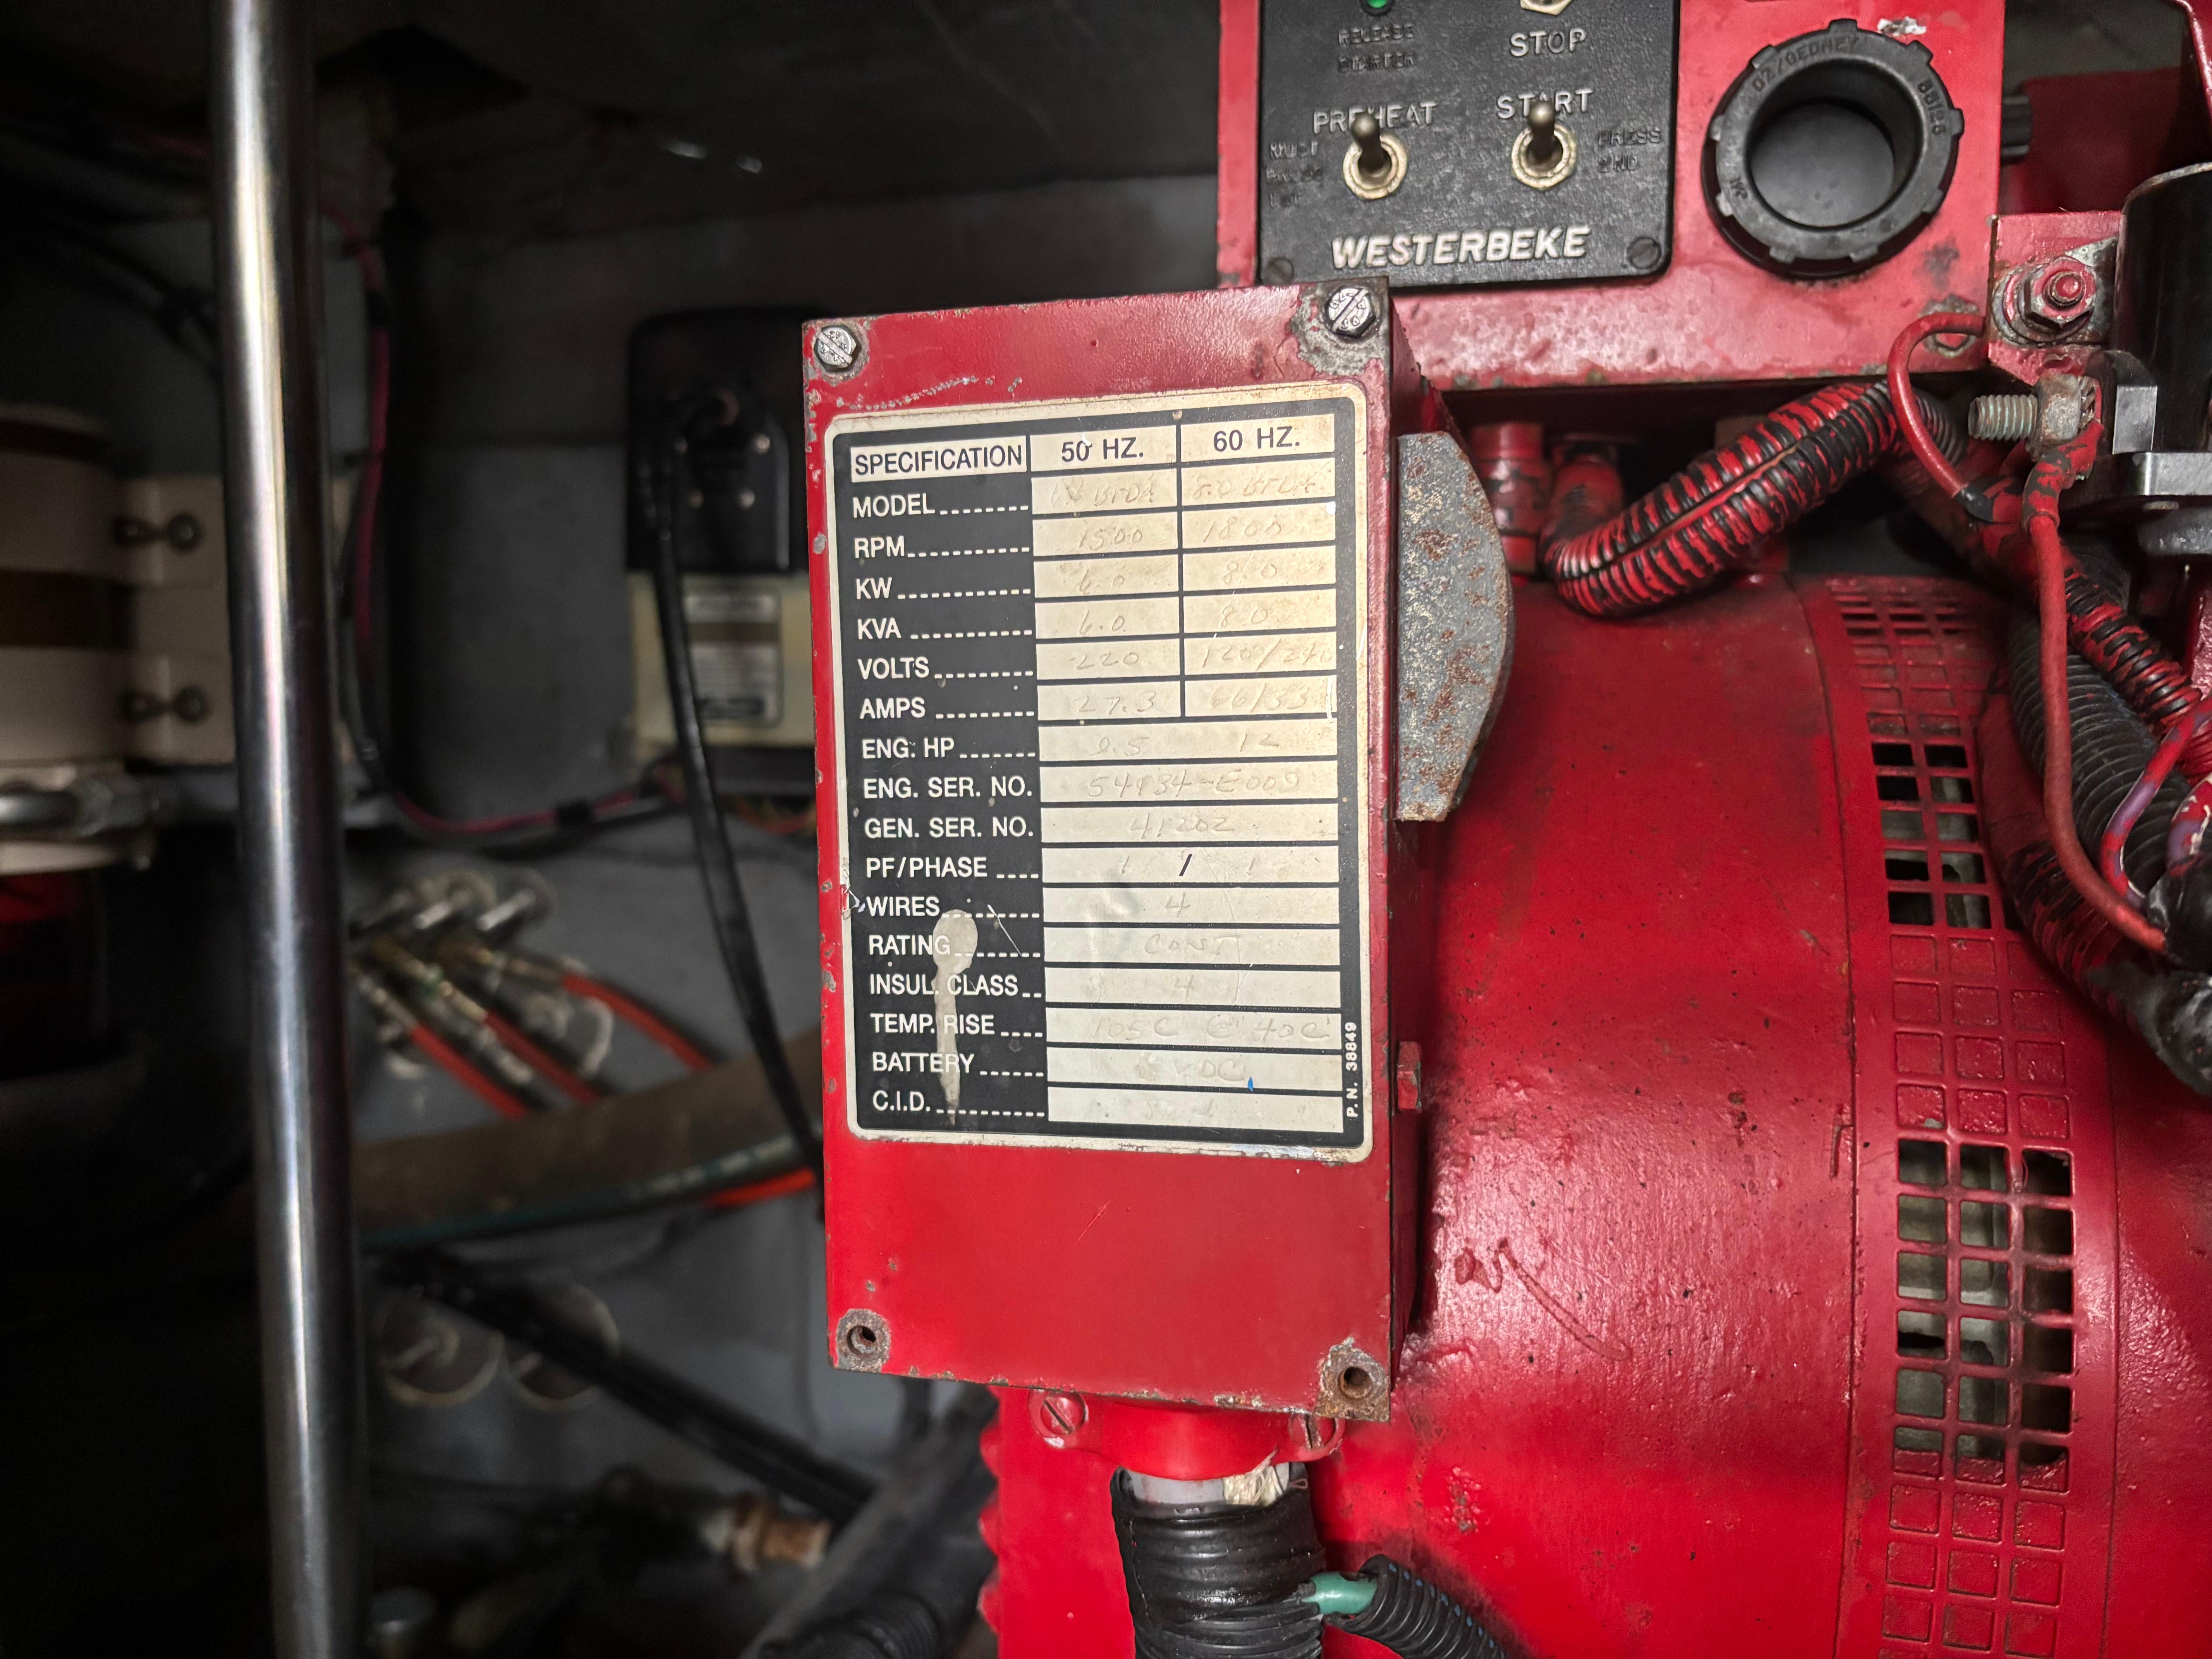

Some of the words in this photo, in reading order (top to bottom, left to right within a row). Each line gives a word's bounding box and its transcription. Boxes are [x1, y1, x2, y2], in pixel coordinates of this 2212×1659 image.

[1511, 27, 1587, 57] STOP
[1332, 225, 1590, 269] WESTERBEKE
[1062, 441, 1091, 462] 50
[1103, 436, 1144, 460] HZ.
[1213, 429, 1242, 452] 60
[1257, 426, 1300, 450] HZ.
[855, 445, 1022, 475] SPECIFICATION
[853, 493, 935, 518] MODEL
[1078, 527, 1143, 551] 1500
[1202, 517, 1282, 543] 1800
[854, 535, 905, 558] RPM
[856, 577, 892, 599] KW
[857, 617, 902, 639] KVA
[857, 656, 929, 680] VOLTS
[1071, 651, 1139, 670] 220
[860, 697, 926, 719] AMPS
[1073, 690, 1157, 715] 27.3
[862, 737, 915, 759] ENG.
[924, 737, 955, 758] HP
[1240, 733, 1279, 752] 12
[863, 777, 918, 799] ENG.
[928, 776, 981, 798] SER.
[991, 775, 1032, 797] NO.
[864, 818, 920, 838] GEN.
[929, 817, 982, 838] SER.
[993, 816, 1033, 837] NO.
[866, 857, 988, 878] PF/PHASE
[866, 896, 940, 917] WIRES
[1165, 892, 1191, 918] 4
[869, 934, 951, 956] RATING
[870, 974, 939, 995] INSUL.
[947, 975, 1018, 996] CLASS
[870, 1013, 935, 1034] TEMP.
[943, 1014, 995, 1035] RISE
[1345, 1022, 1357, 1071] 38849
[872, 1051, 975, 1073] BATTERY
[872, 1090, 930, 1112] C.I.D.
